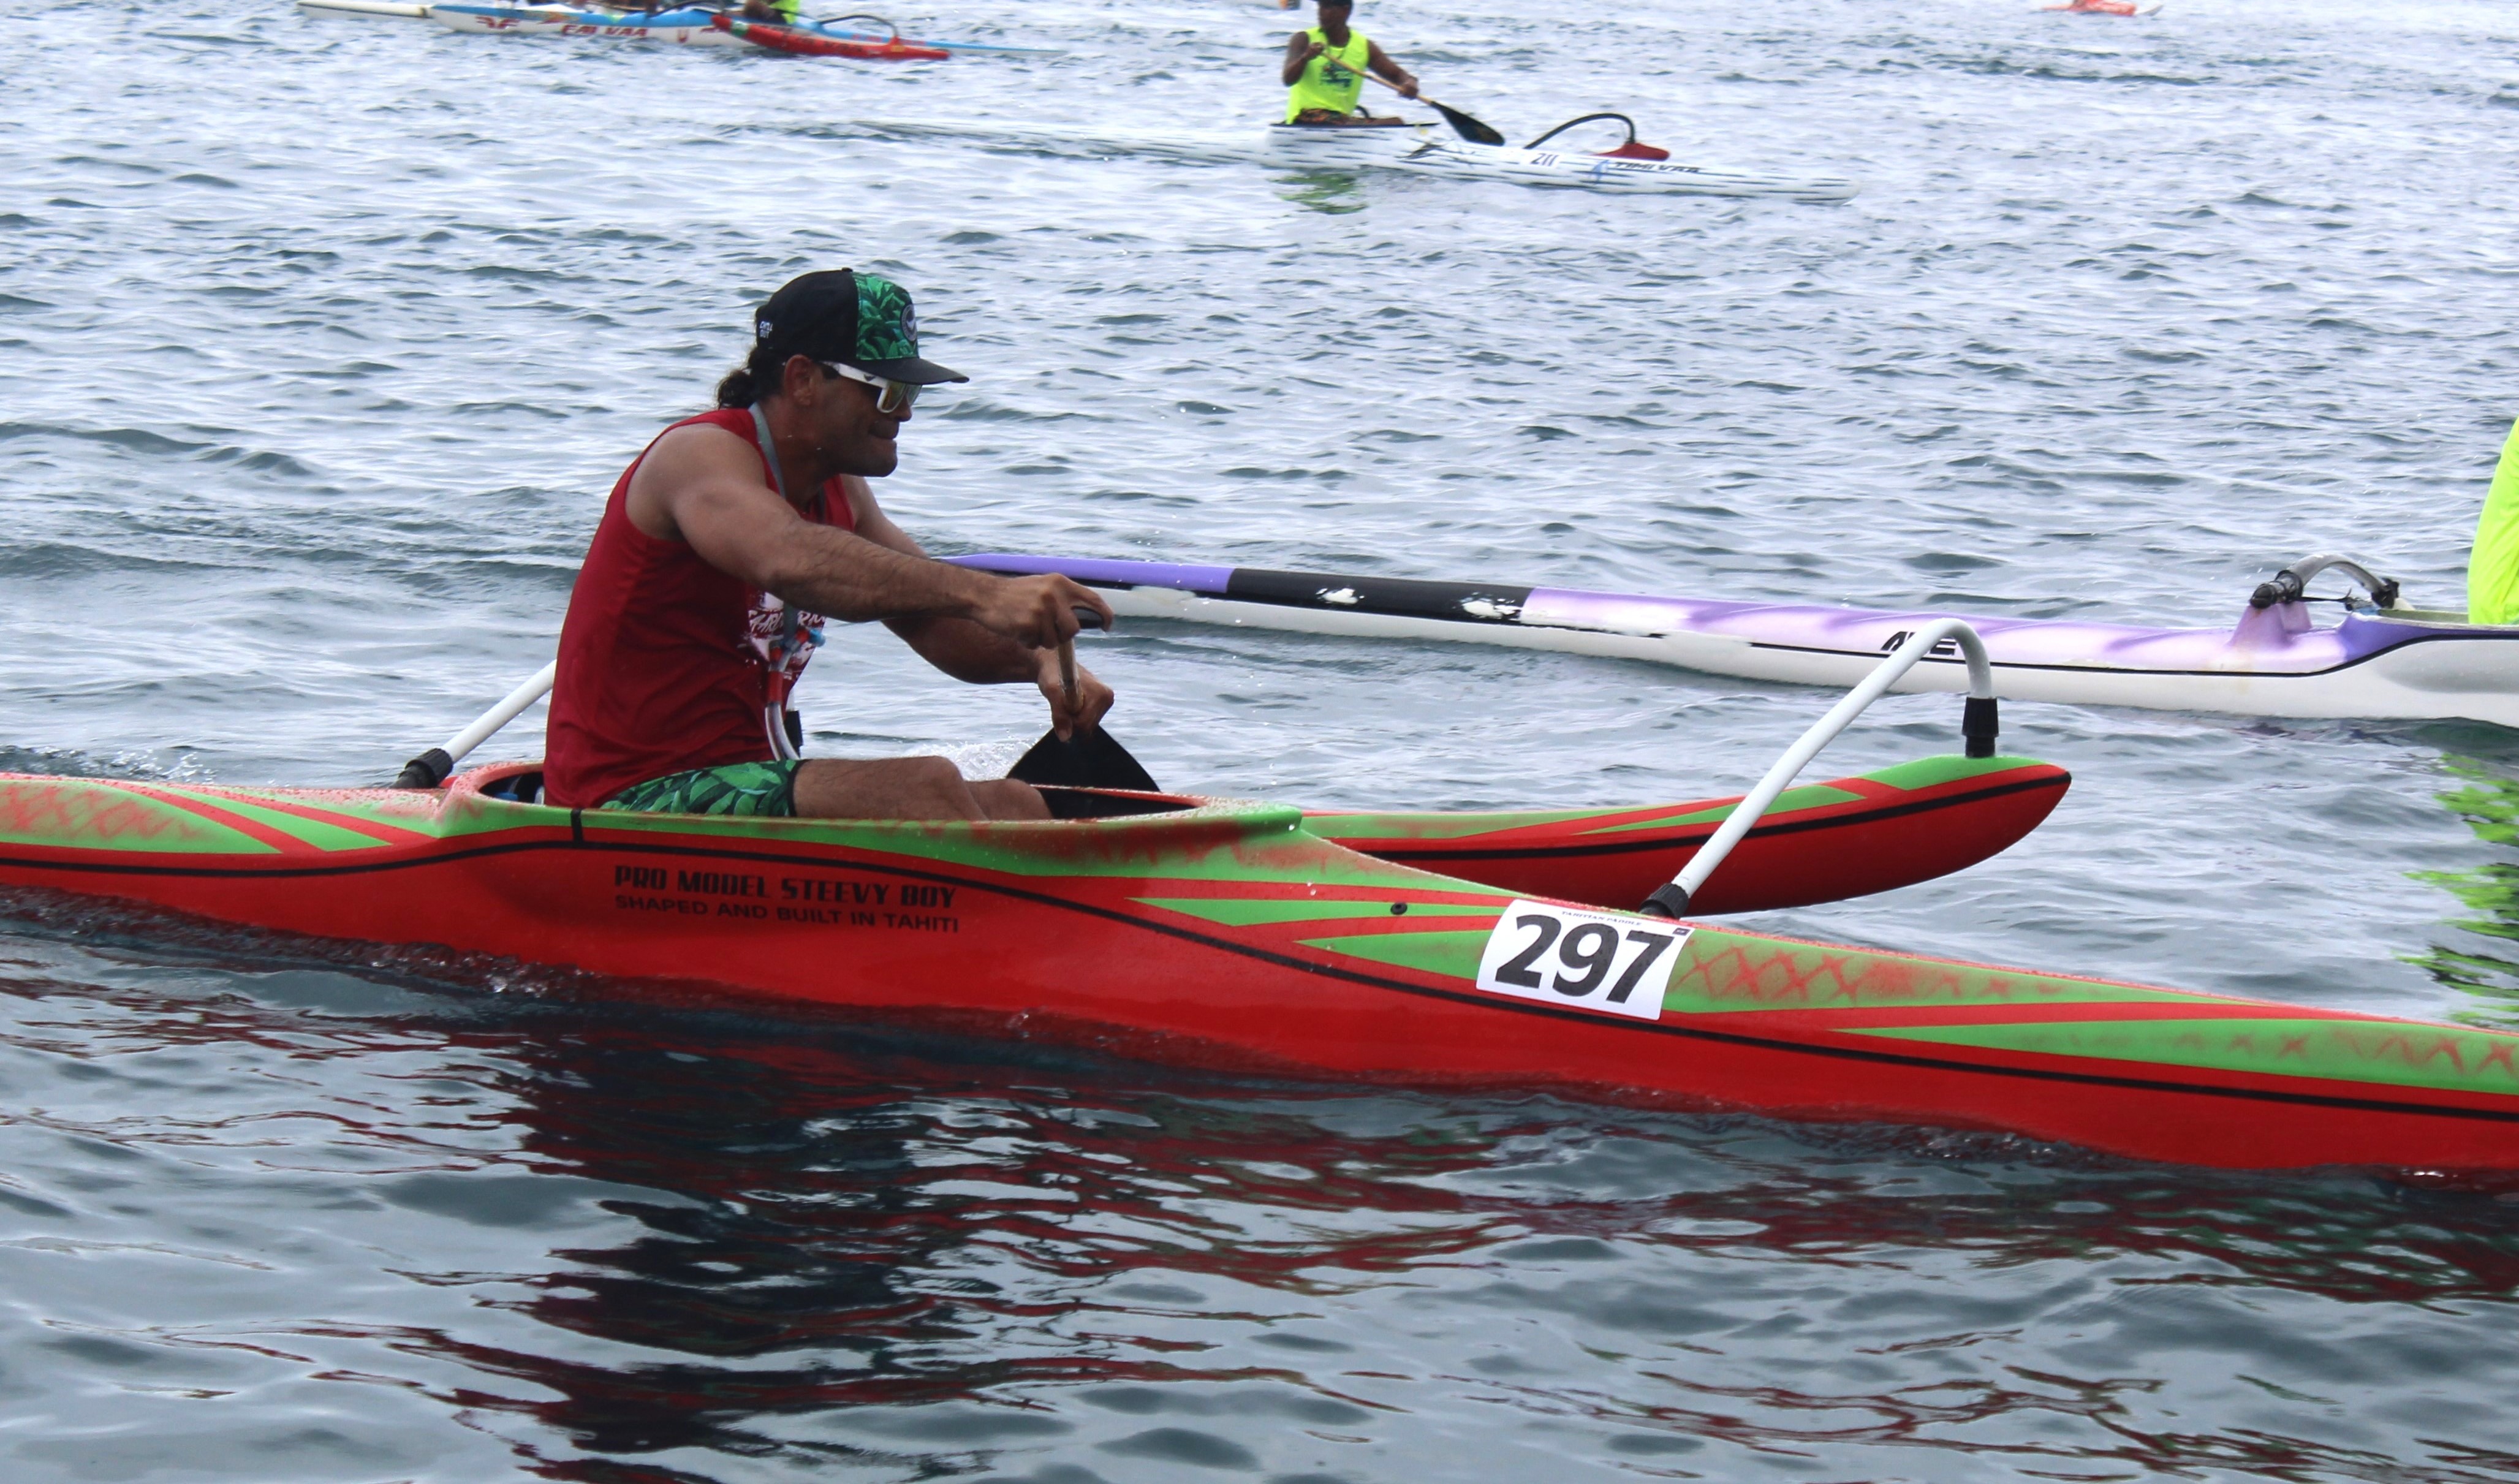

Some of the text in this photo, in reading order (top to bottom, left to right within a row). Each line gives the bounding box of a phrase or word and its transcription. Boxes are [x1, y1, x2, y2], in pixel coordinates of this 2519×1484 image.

[615, 865, 956, 909] PRO MODEL STEEVY BOY
[615, 895, 958, 933] SHAPED AND BUILT IN TAHITI
[1562, 910, 1642, 926] TAHITIAN PADDLE
[1495, 914, 1675, 1004] 297
